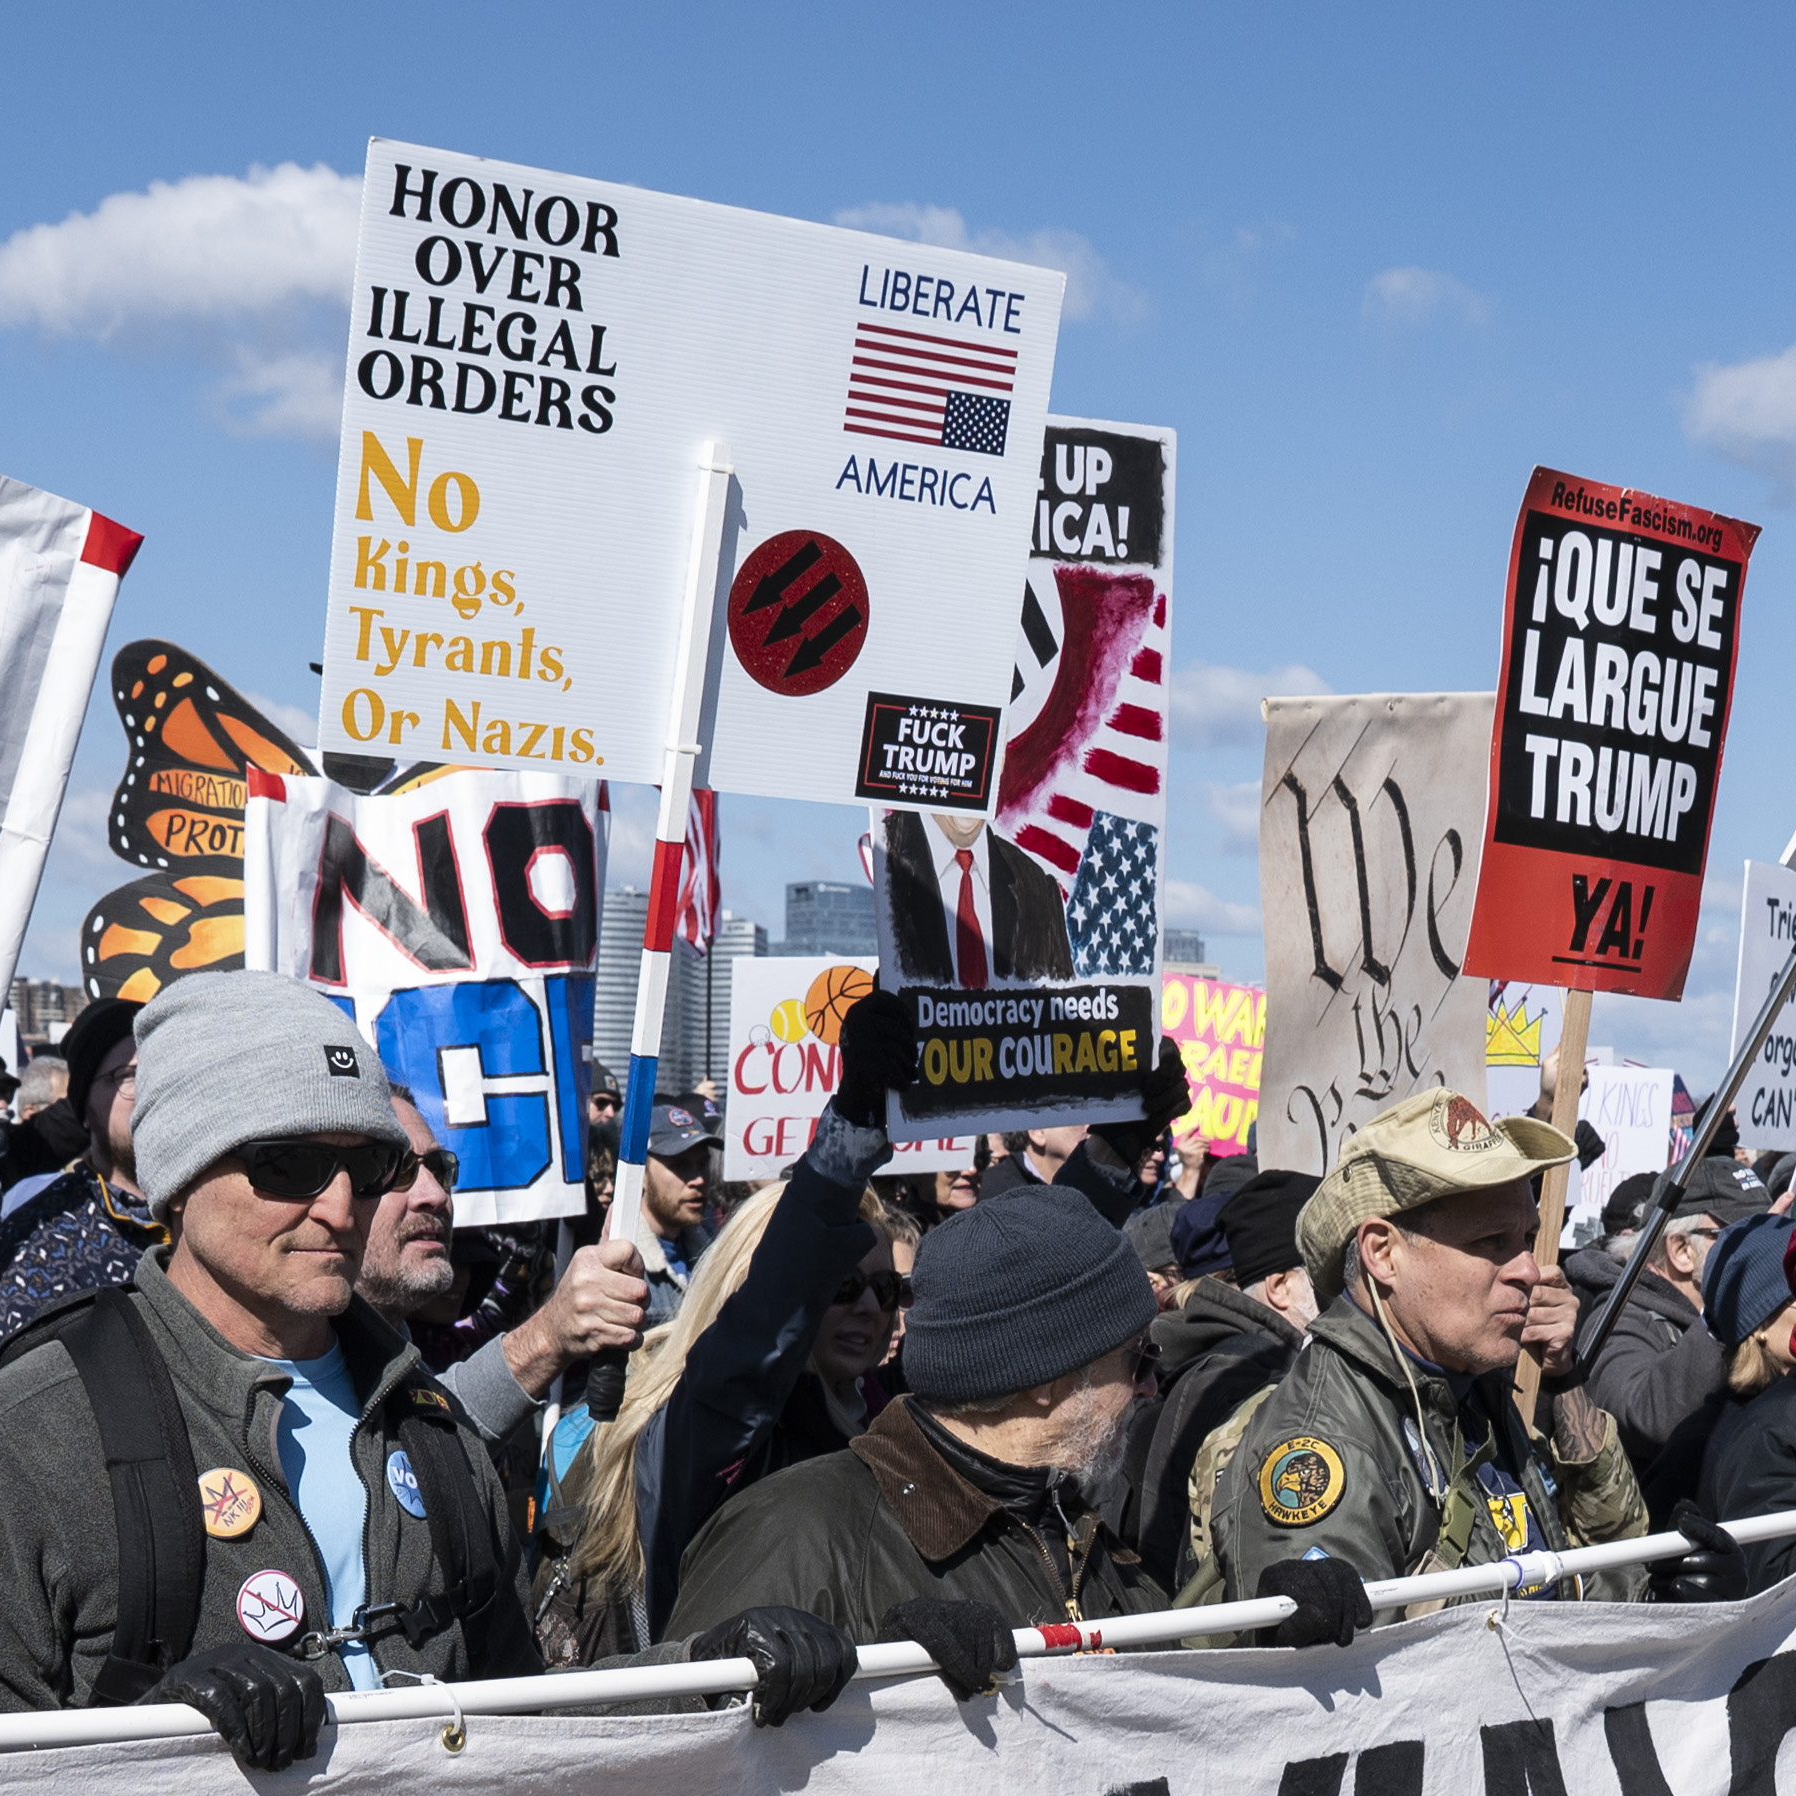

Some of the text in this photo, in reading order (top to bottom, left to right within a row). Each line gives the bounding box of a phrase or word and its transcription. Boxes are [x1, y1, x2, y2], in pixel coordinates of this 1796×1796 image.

[389, 163, 621, 258] HONOR
[414, 235, 584, 313] OVER
[857, 264, 1026, 334] LIBERATE
[366, 285, 618, 377] ILLEGAL
[356, 349, 617, 435] ORDERS
[354, 430, 482, 534] No
[835, 453, 998, 515] AMERICA
[1054, 441, 1114, 497] UP
[1031, 499, 1130, 559] ICA!
[1550, 480, 1724, 554] RefuseFascism.org
[354, 535, 525, 619] Kings,
[1532, 529, 1729, 650] ¡QUE SE
[348, 605, 574, 693] Tyrants,
[1518, 628, 1720, 750] LARGUE
[341, 687, 606, 767] Or Nazis.
[882, 743, 976, 777] TRUMP
[897, 717, 966, 750] FUCK
[156, 772, 247, 809] MIGRATIO
[879, 769, 891, 779] AND
[892, 771, 906, 780] FUCK
[906, 772, 918, 782] YOU
[919, 774, 929, 783] FOR
[950, 778, 961, 787] FOR
[961, 779, 973, 788] HIM
[1524, 731, 1698, 843] TRUMP
[309, 797, 598, 988] NO
[1568, 872, 1656, 960] YA!
[917, 986, 1120, 1029] Democracy needs
[1162, 979, 1189, 1030] O
[734, 1041, 843, 1096] CON
[998, 1028, 1138, 1079] COURAGE
[1431, 1101, 1444, 1135] KENYA
[1598, 1080, 1660, 1129] KINGS
[1286, 1438, 1319, 1452] E-2C
[1267, 1500, 1330, 1522] HAWKEYE
